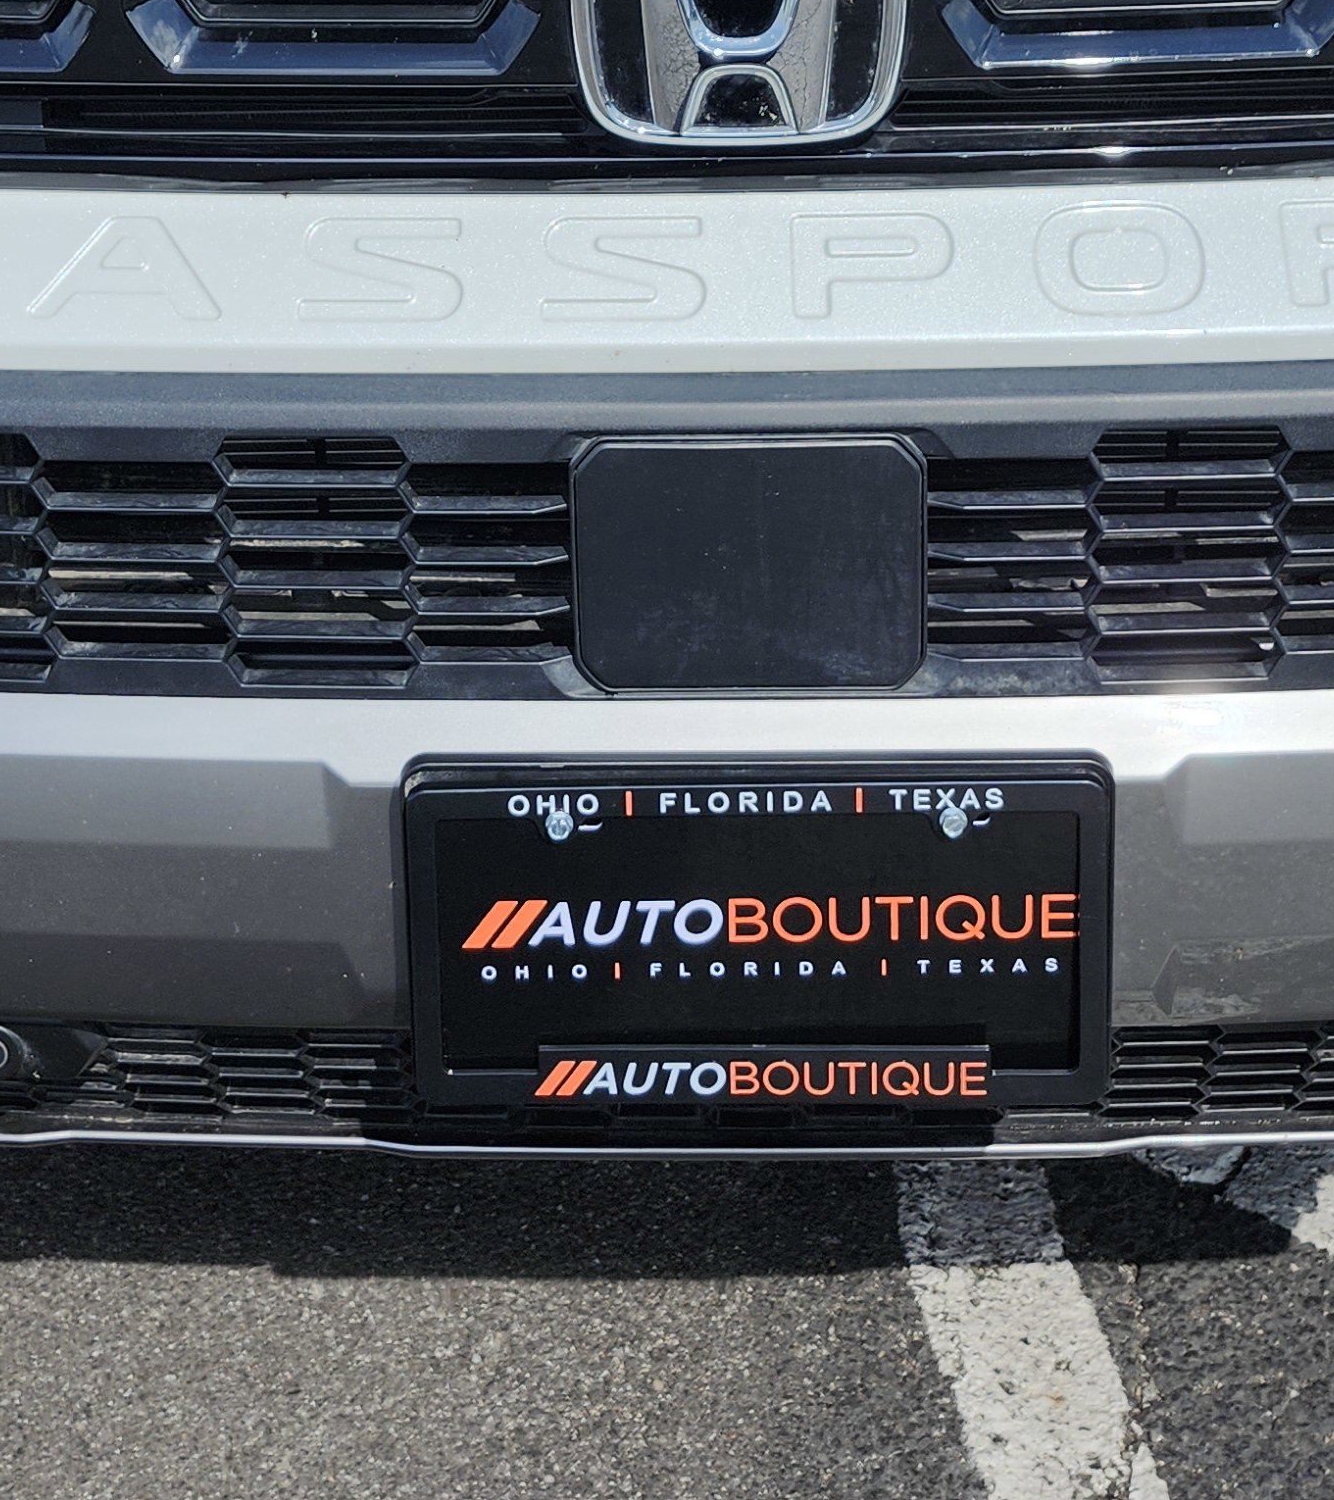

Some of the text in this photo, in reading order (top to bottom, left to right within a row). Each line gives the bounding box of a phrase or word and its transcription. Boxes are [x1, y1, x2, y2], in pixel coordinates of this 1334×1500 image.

[507, 787, 1005, 817] OHIO FLORIDA TEXAS
[527, 893, 1079, 947] AUTOBOUTIQUE
[480, 957, 1060, 981] OHIO FLORIDA TEXAS
[582, 1060, 988, 1096] AUTOBOUTIQUE
